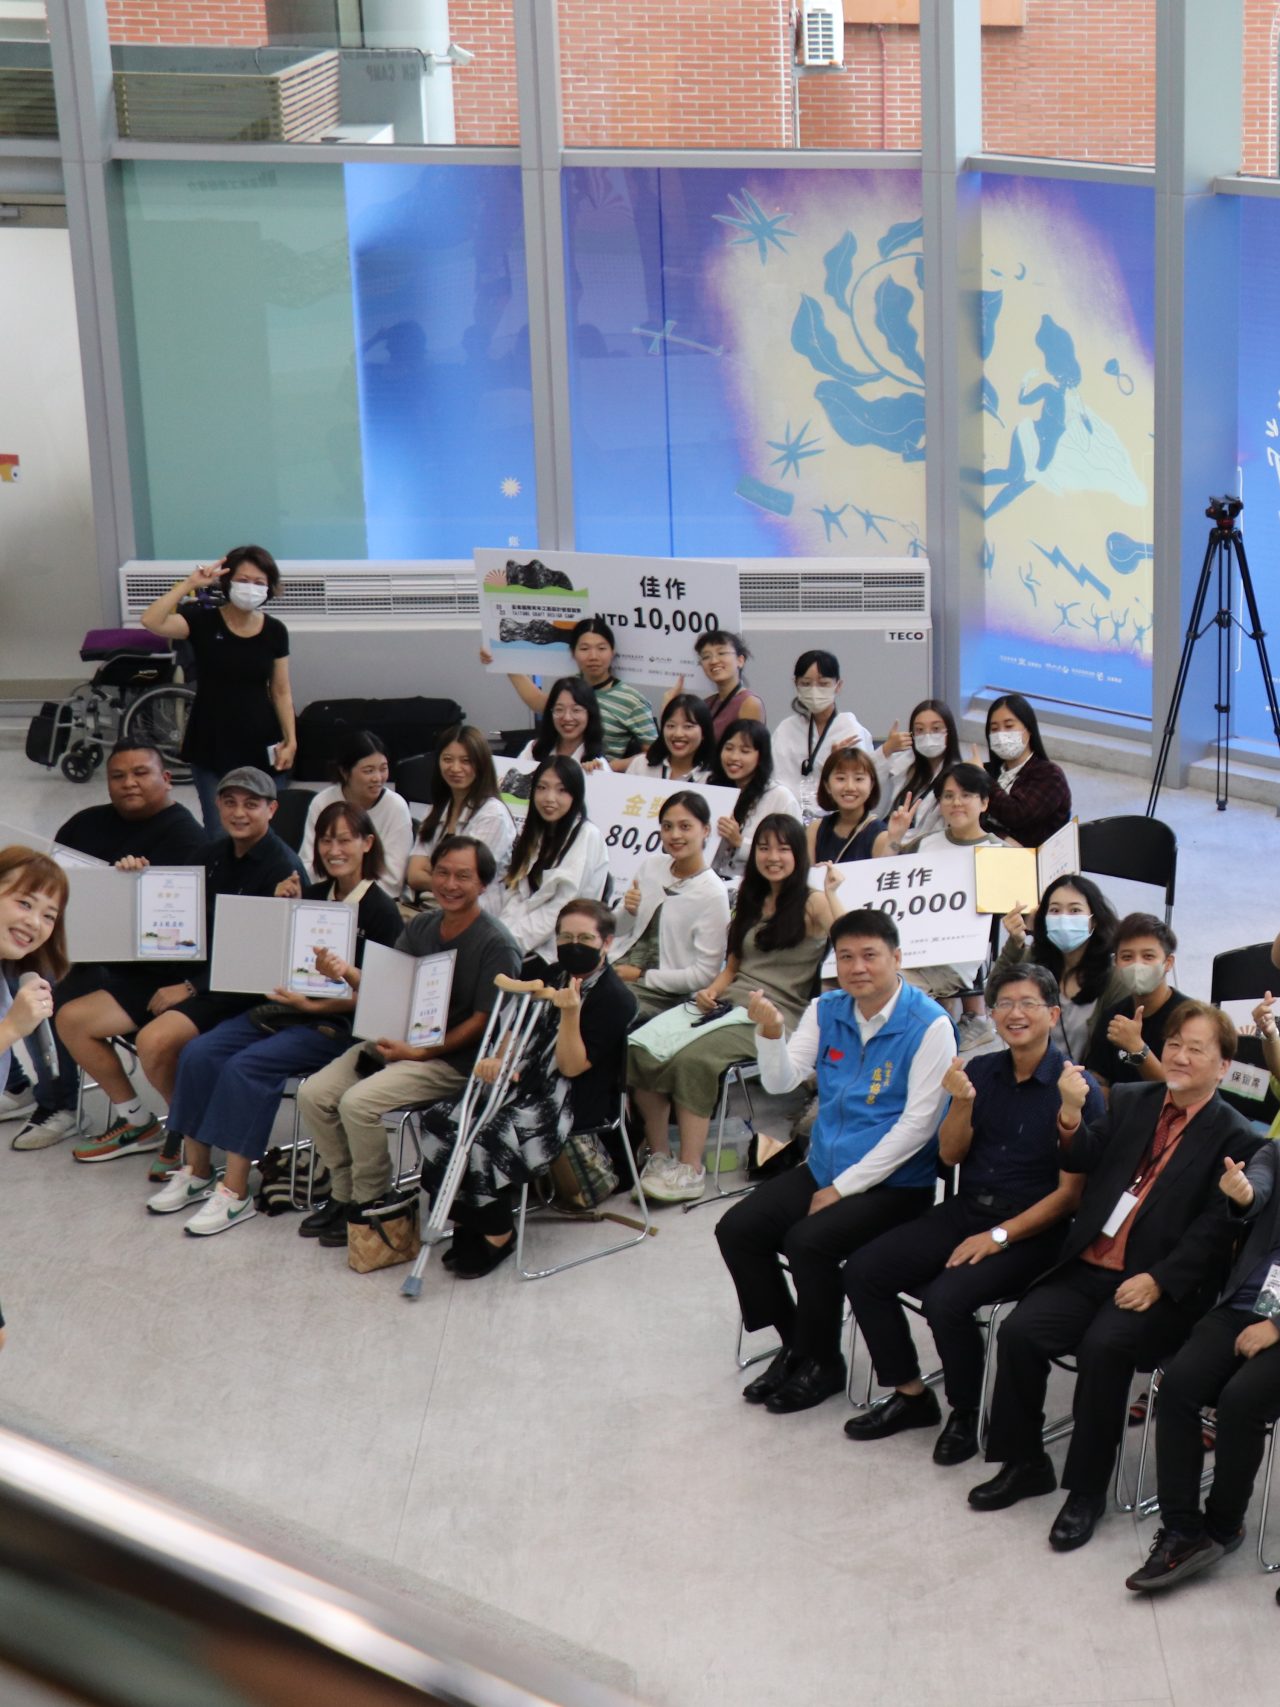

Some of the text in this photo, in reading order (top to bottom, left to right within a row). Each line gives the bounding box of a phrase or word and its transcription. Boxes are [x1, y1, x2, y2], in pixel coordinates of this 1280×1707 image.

[640, 575, 686, 600] 佳作
[594, 606, 720, 635] NTD 10,000
[888, 631, 925, 641] TECO
[605, 824, 662, 855] 80,0
[876, 867, 933, 892] 佳作
